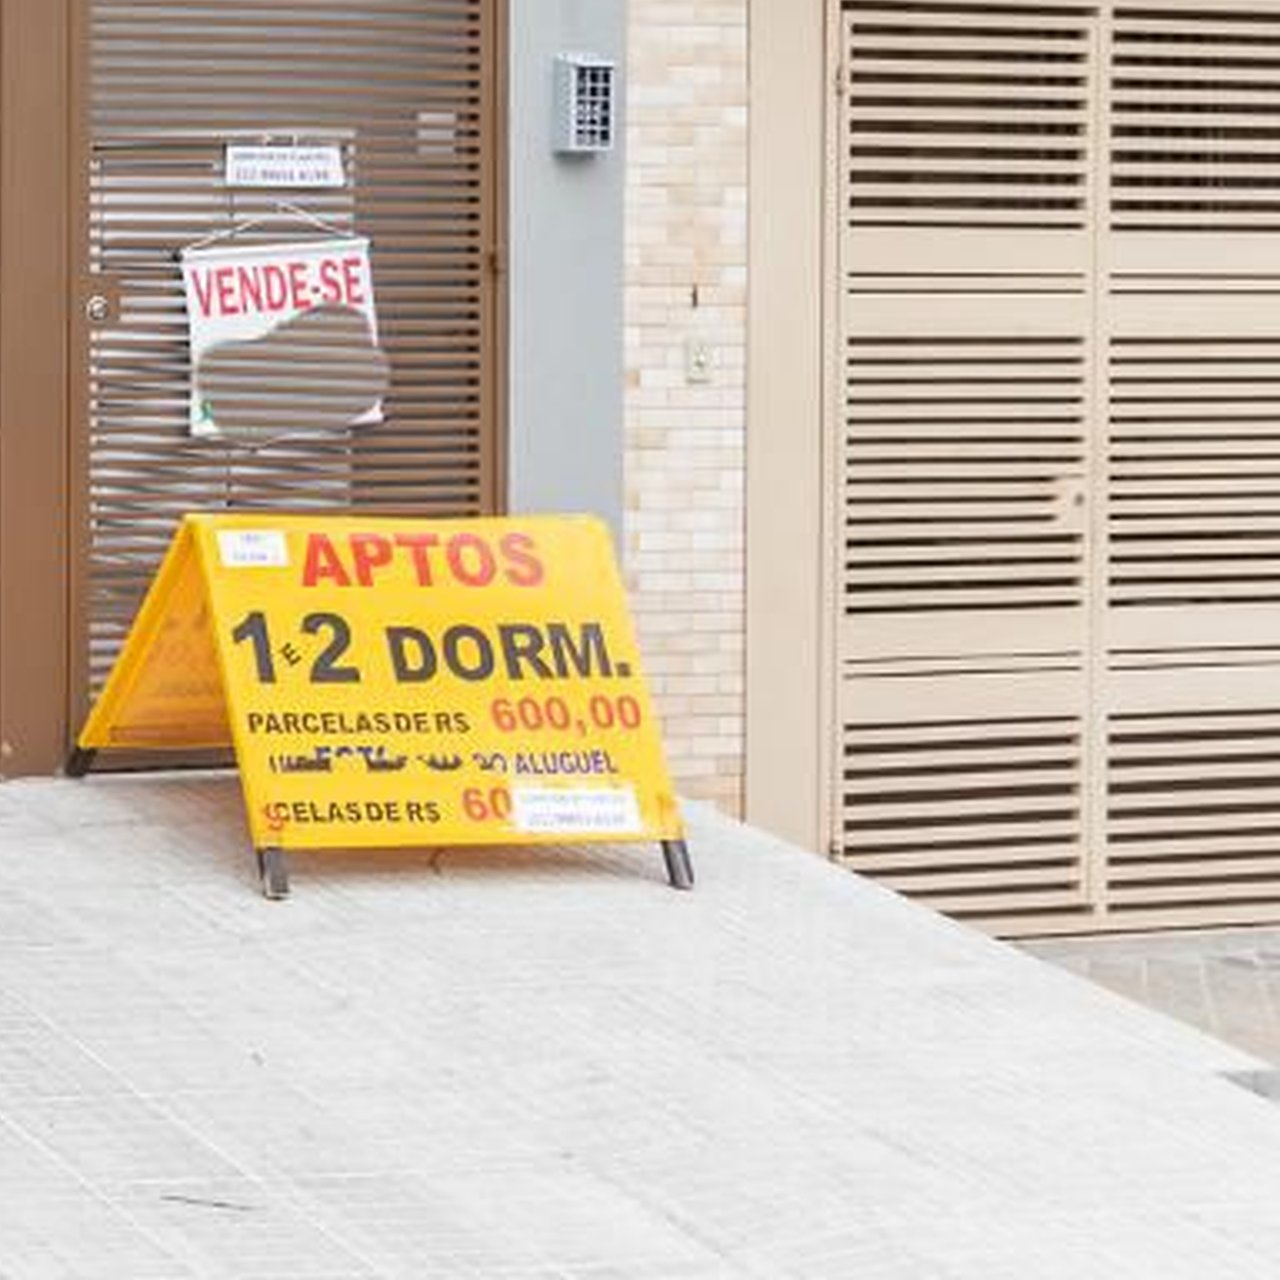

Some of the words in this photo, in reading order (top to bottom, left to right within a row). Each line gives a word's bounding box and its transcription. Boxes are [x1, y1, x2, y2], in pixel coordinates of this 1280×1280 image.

[191, 258, 365, 318] VENDE-SE
[301, 531, 546, 588] APTOS
[384, 622, 634, 684] DORM.
[491, 694, 642, 737] 600,00
[515, 750, 620, 775] ALUGUEL
